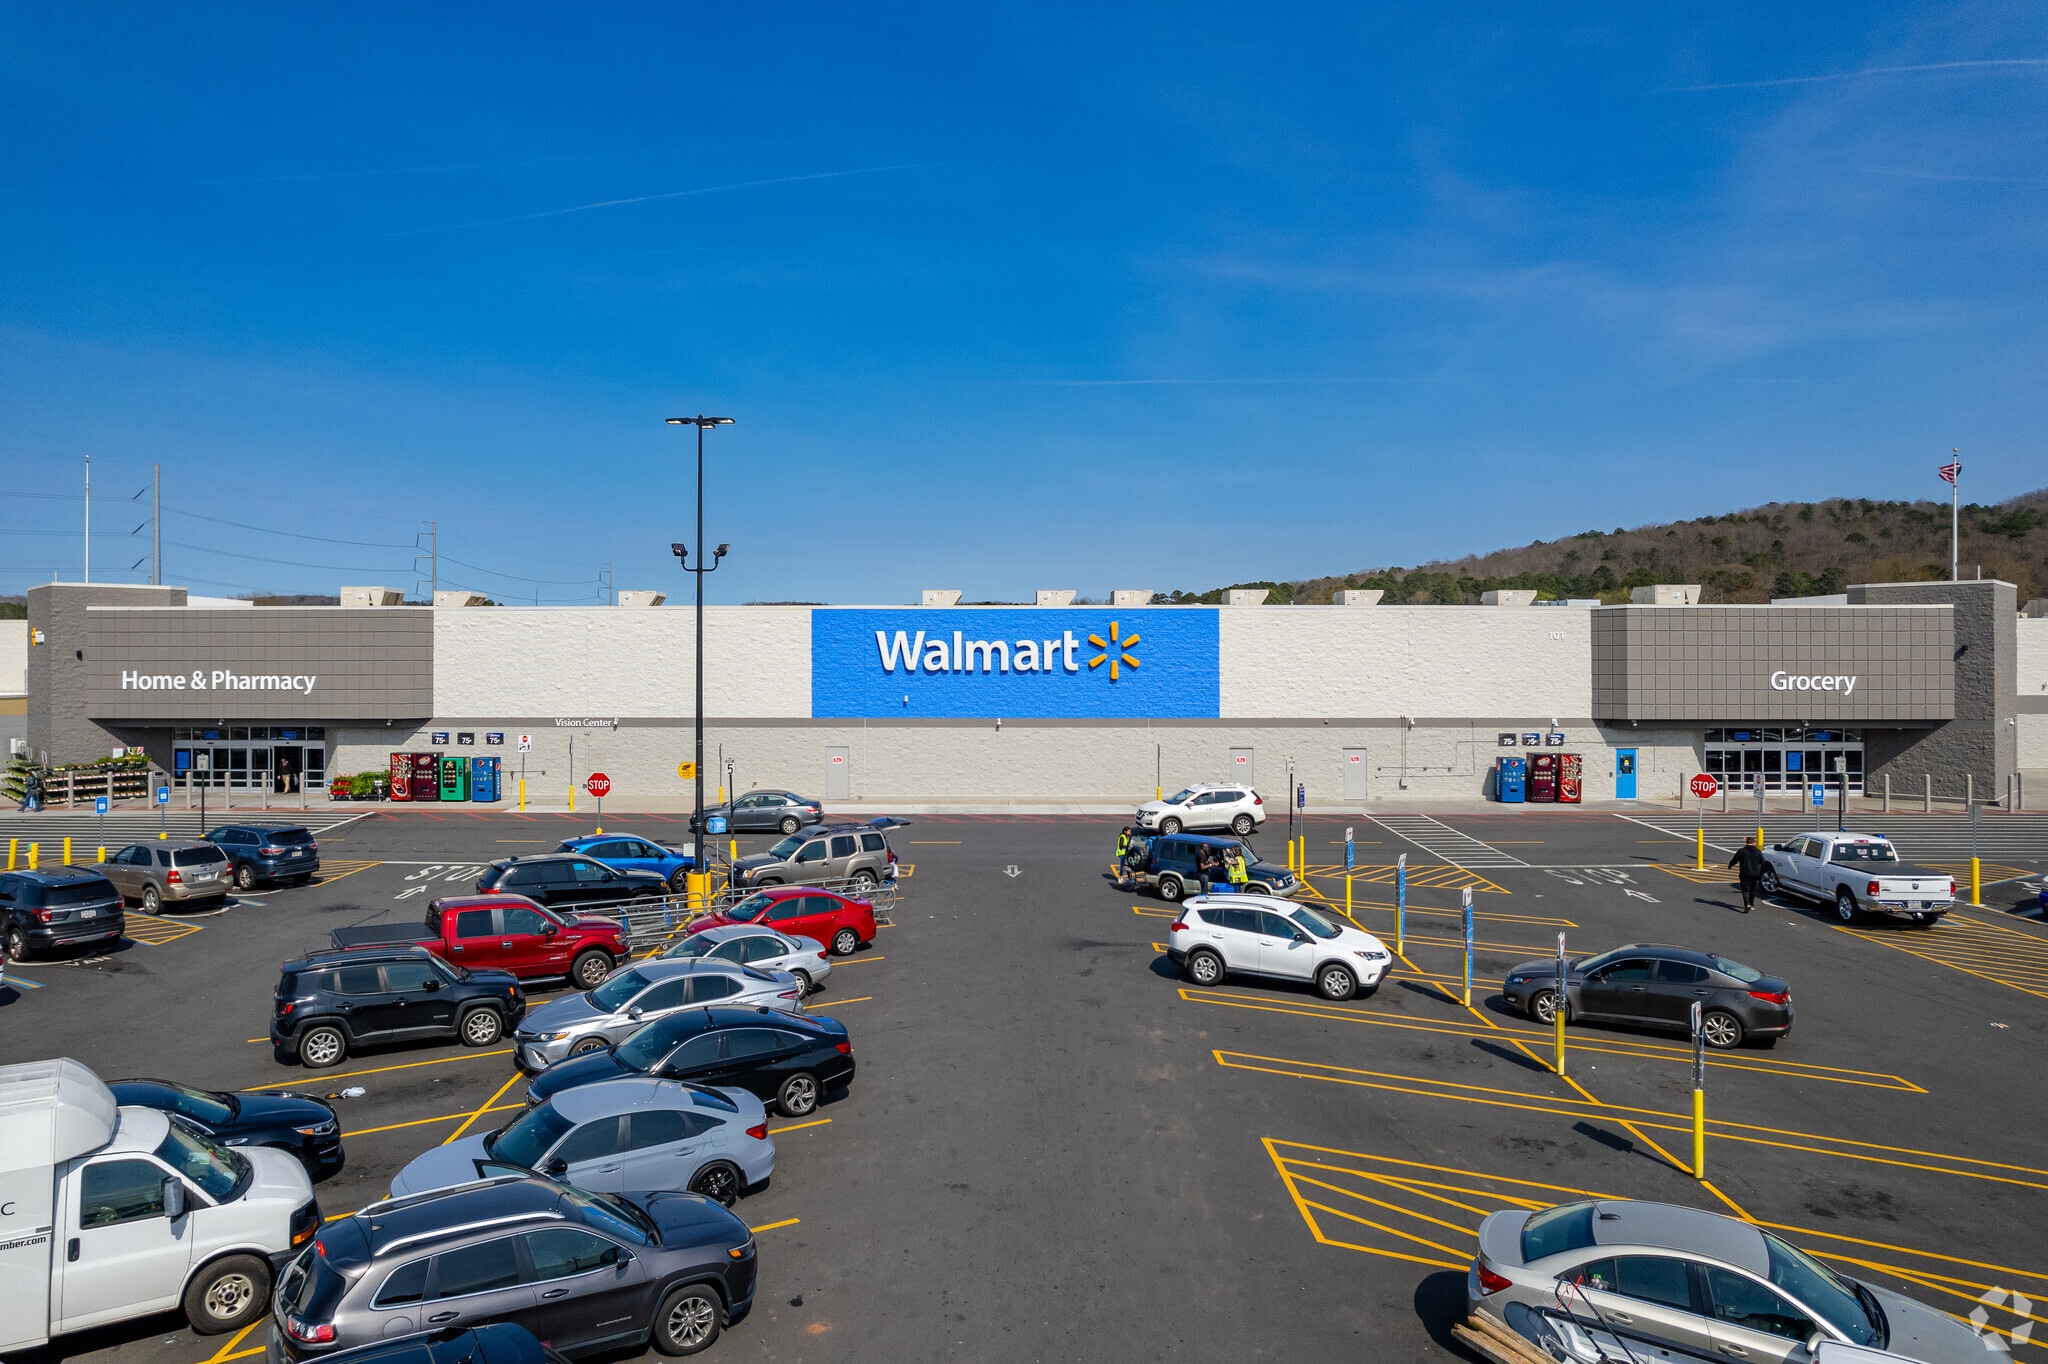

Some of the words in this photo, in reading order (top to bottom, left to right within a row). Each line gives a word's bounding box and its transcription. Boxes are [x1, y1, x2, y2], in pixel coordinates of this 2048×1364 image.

[1548, 631, 1564, 641] 101
[876, 630, 1079, 672] Walmart
[122, 670, 186, 690] Home
[191, 670, 207, 690] &
[212, 670, 316, 696] Pharmacy
[1771, 670, 1857, 696] Grocery
[555, 718, 582, 727] Vision
[583, 718, 612, 727] Center
[727, 764, 733, 774] 5
[588, 779, 609, 790] STOP
[1691, 780, 1715, 792] STOP
[1544, 869, 1638, 884] STOP
